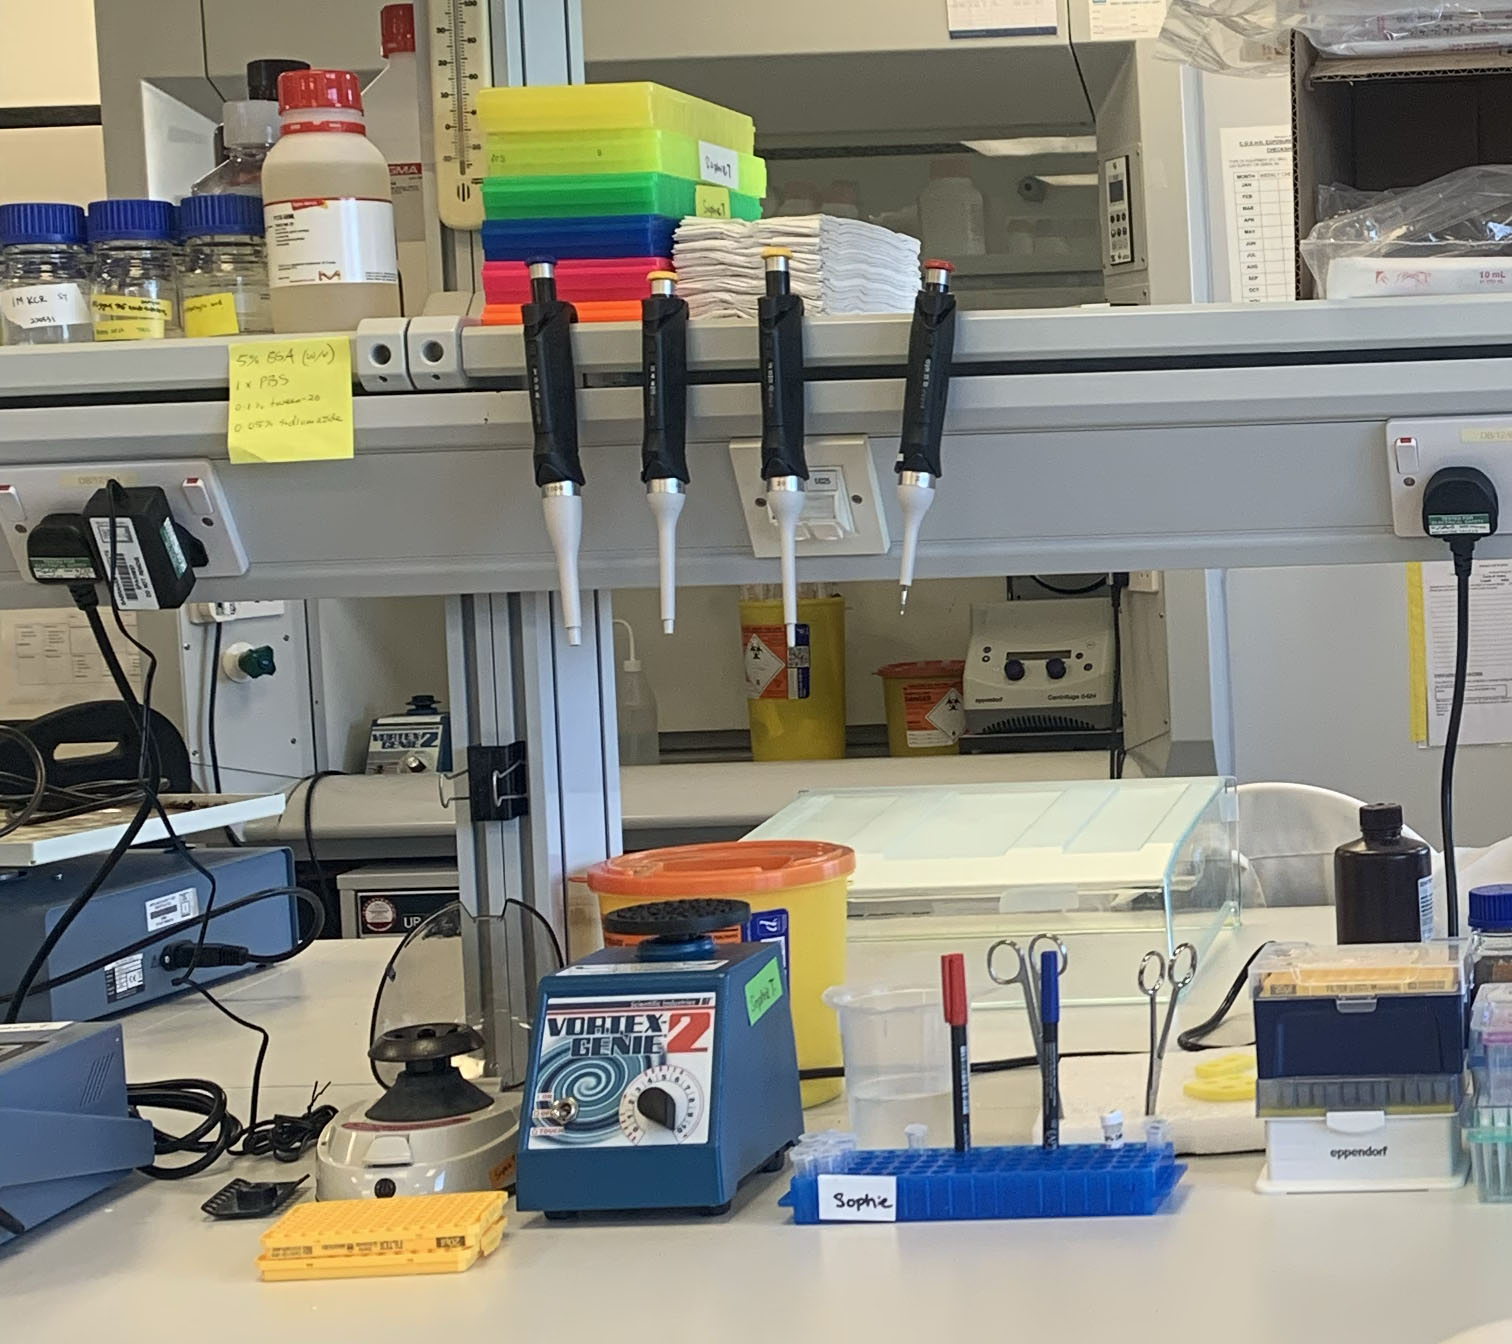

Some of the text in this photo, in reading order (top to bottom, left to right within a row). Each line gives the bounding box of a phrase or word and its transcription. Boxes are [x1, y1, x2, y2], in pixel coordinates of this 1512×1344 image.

[266, 348, 295, 364] BSA
[259, 374, 289, 389] PBS
[667, 1011, 711, 1054] 2
[1329, 1145, 1388, 1159] eppendorf
[833, 1192, 894, 1213] Sophie
